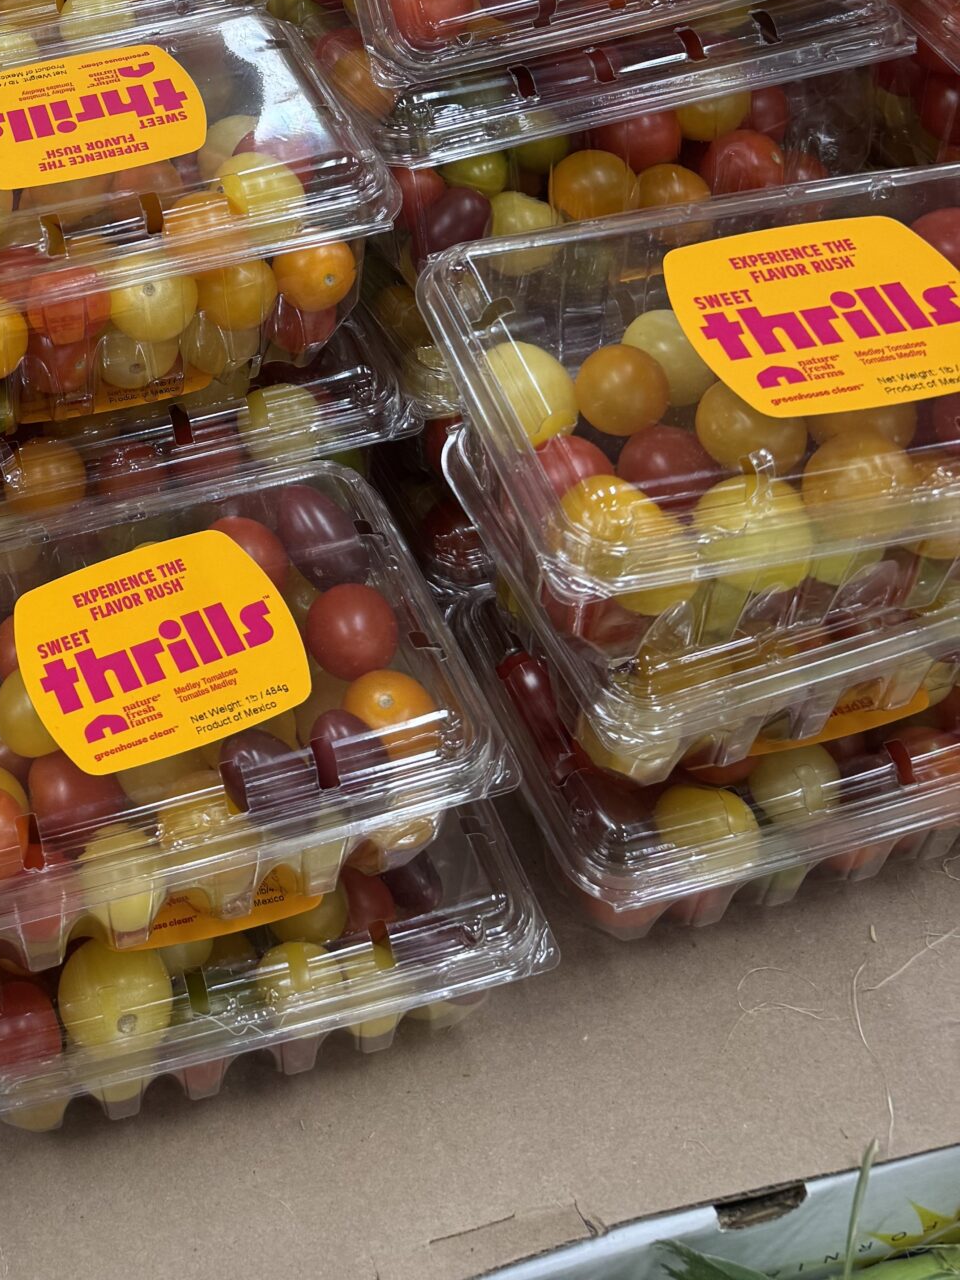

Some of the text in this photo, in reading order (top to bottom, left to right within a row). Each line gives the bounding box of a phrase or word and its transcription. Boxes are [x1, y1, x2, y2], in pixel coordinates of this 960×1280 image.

[139, 110, 188, 130] SWEET
[85, 133, 136, 151] FLAVOR
[38, 141, 150, 172] EXPERIENCE THE
[728, 238, 857, 270] EXPERIENCE THE
[749, 263, 811, 284] FLAVOR
[693, 288, 753, 311] SWEET
[72, 558, 187, 609] EXPERIENCE THE
[89, 592, 144, 622] FLAVOR
[36, 628, 90, 660] SWEET
[173, 667, 239, 696] Medley Tomatoes
[209, 677, 238, 692] Medley
[125, 703, 156, 721] fresh
[128, 710, 164, 729] farms
[189, 712, 209, 724] Net
[195, 716, 233, 735] Product
[243, 701, 277, 718] Mexico
[93, 737, 149, 762] greenhouse
